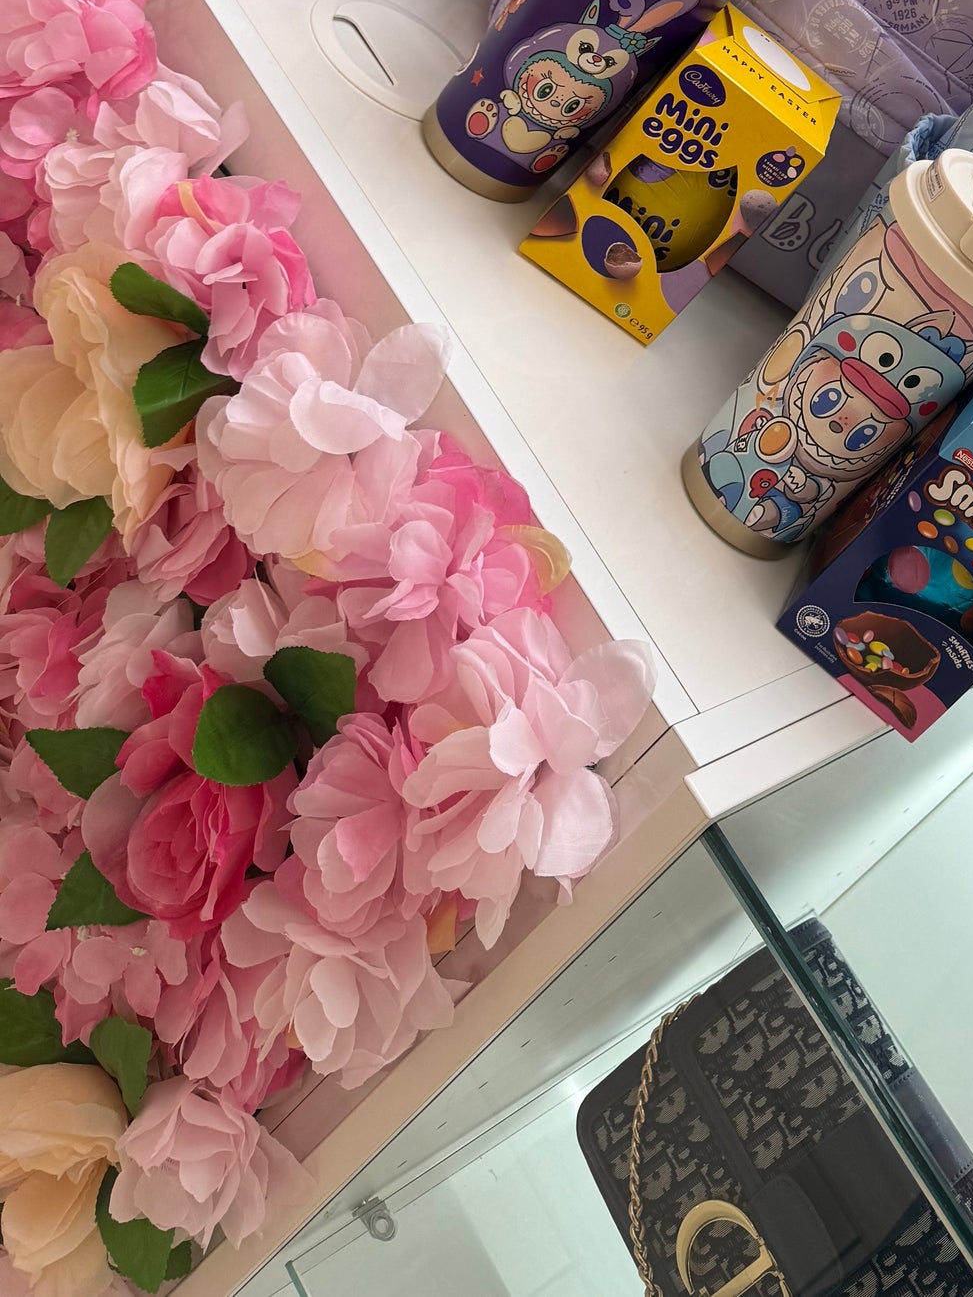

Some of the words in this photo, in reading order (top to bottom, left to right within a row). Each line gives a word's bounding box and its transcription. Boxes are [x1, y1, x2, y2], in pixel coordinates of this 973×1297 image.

[891, 8, 918, 24] 1926
[683, 69, 722, 105] Cadbury
[721, 44, 765, 82] HAPPY
[769, 82, 818, 127] EASTER
[654, 91, 731, 147] Mini
[641, 116, 720, 170] eggs
[945, 645, 963, 670] inside
